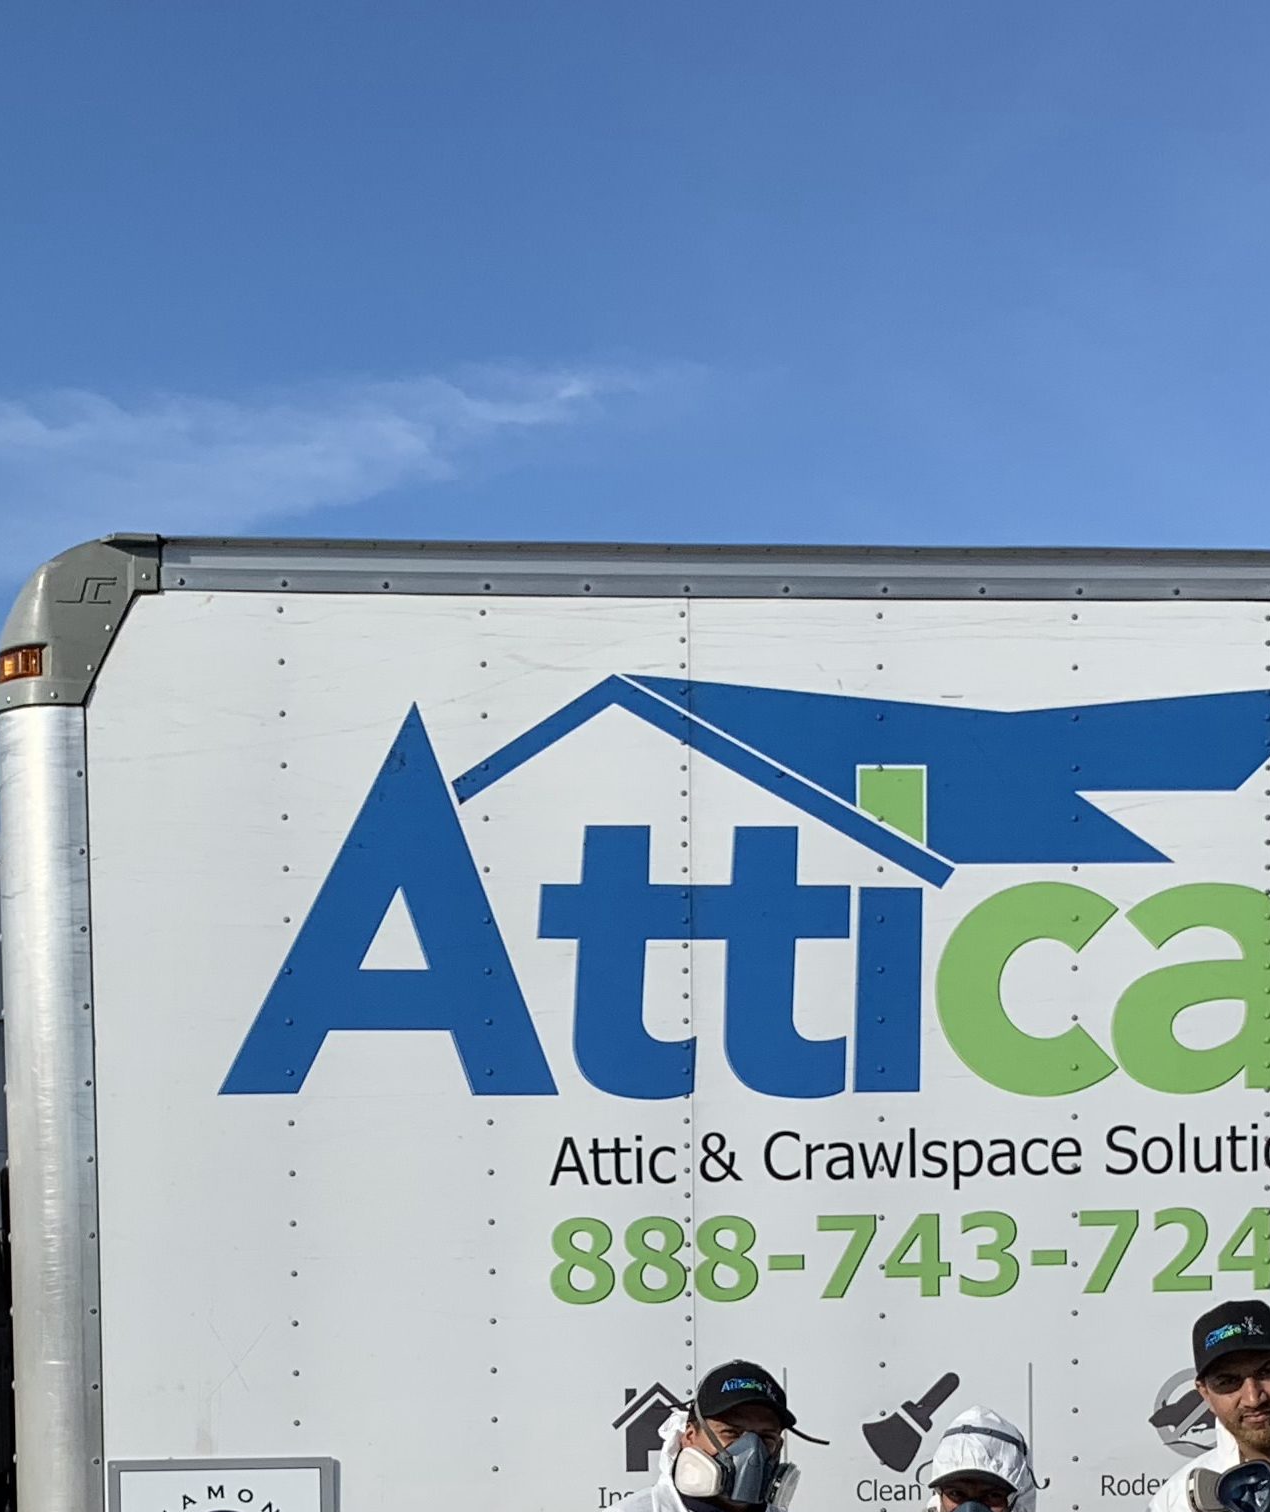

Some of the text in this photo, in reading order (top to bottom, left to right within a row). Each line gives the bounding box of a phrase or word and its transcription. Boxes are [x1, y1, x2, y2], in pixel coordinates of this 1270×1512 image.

[549, 1134, 678, 1186] Attic
[699, 1131, 744, 1183] &
[763, 1127, 1082, 1190] Crawlspace
[856, 1479, 922, 1502] Clean
